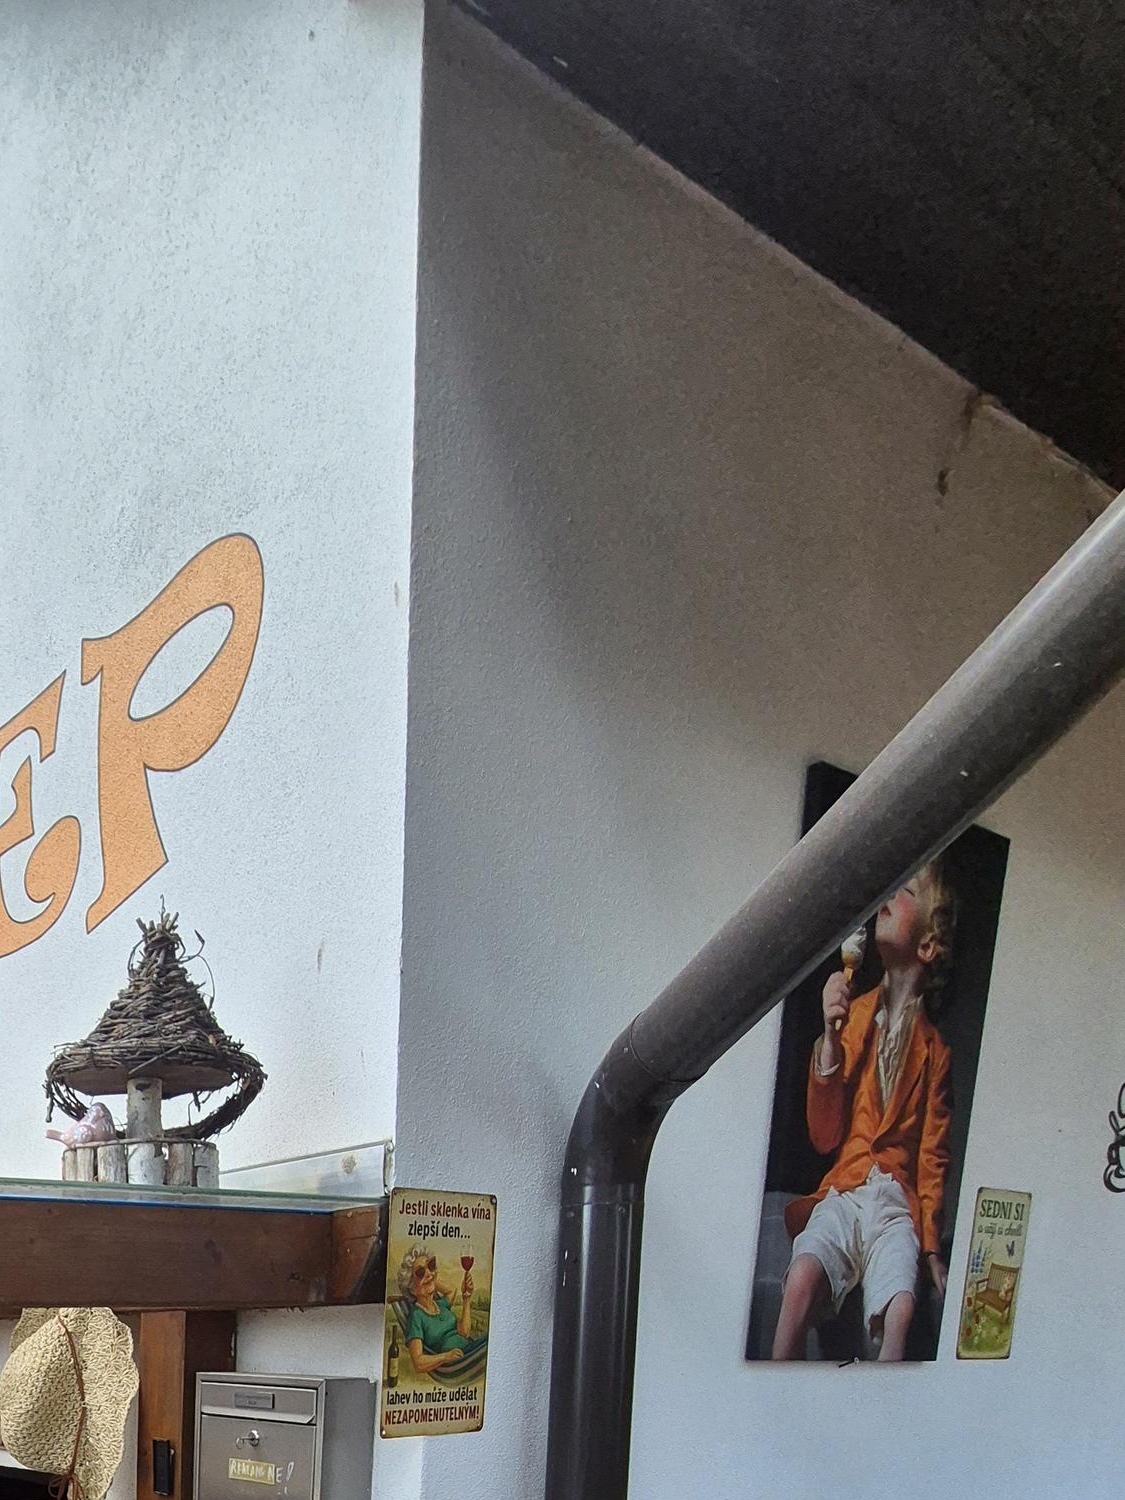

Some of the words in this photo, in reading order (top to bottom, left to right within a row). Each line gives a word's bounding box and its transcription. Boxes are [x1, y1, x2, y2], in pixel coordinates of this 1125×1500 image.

[399, 1199, 429, 1217] Jestli
[430, 1201, 469, 1219] sklenka
[472, 1203, 491, 1220] vína
[979, 1199, 1013, 1220] SEDNI
[1013, 1203, 1025, 1221] SI
[408, 1220, 440, 1240] zlepší
[441, 1222, 471, 1239] den...
[386, 1390, 411, 1405] lahev
[412, 1390, 424, 1404] ho
[425, 1386, 447, 1403] může
[449, 1387, 477, 1402] udělat
[384, 1402, 480, 1426] NEZAPOMENUTELNÝM!
